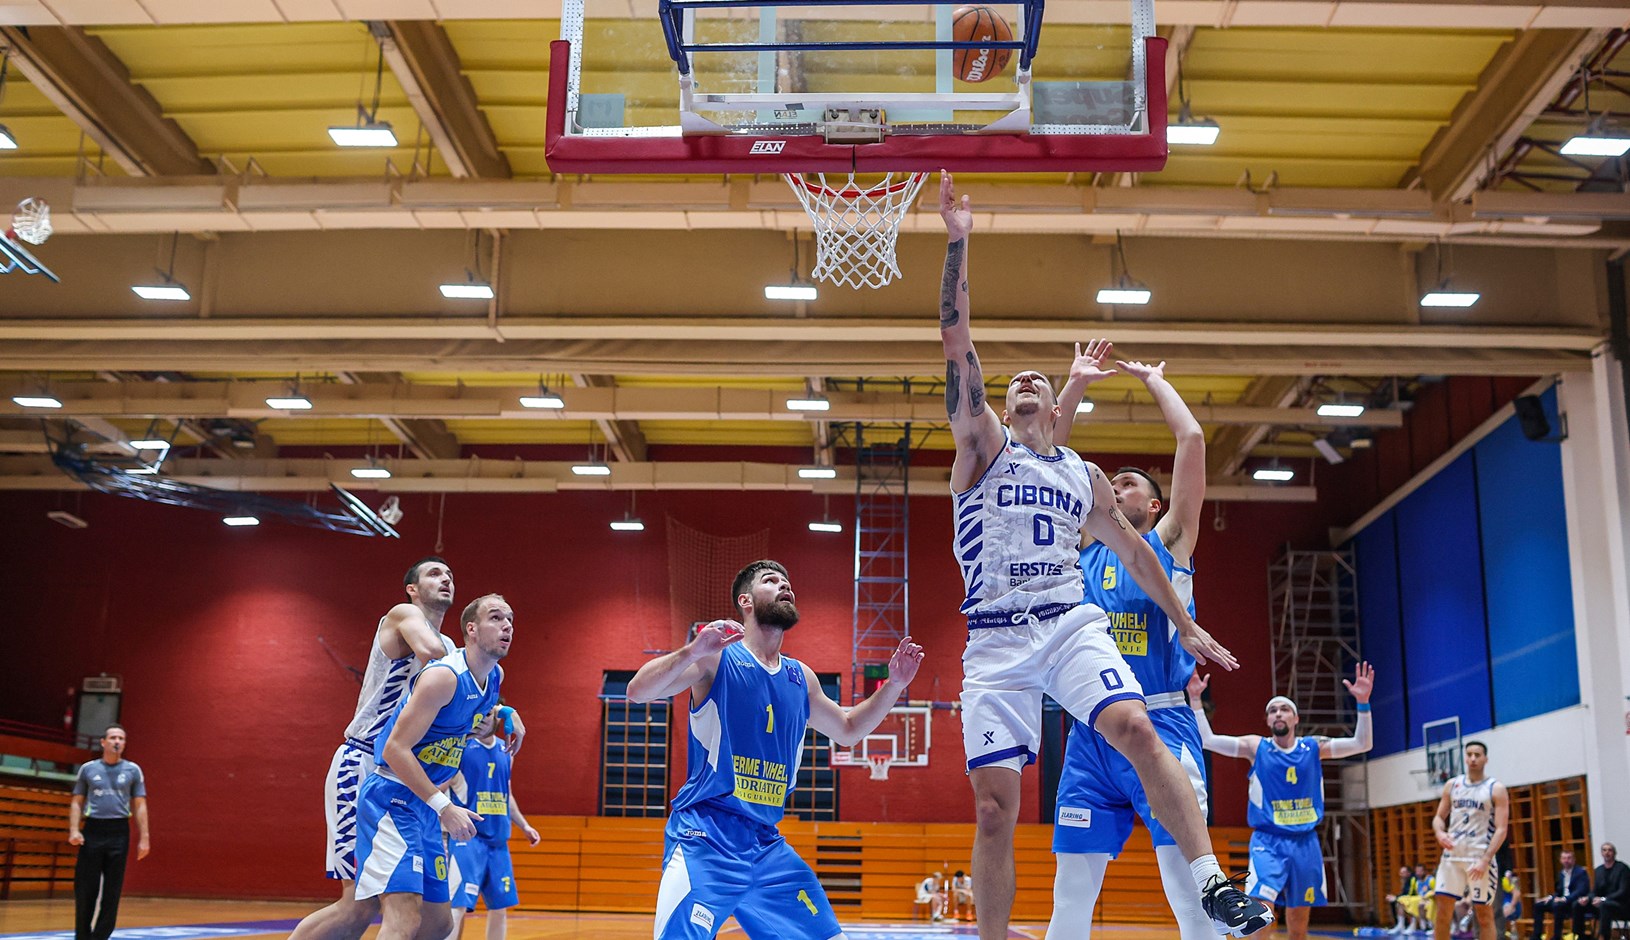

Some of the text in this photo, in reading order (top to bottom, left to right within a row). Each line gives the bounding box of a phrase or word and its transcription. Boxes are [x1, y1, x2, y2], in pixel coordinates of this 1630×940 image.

[966, 34, 992, 81] Wilson
[750, 141, 787, 154] ELAN
[997, 484, 1083, 523] CIBONA
[1033, 513, 1054, 546] 0
[1009, 578, 1031, 588] Ban
[1102, 565, 1117, 590] 5
[1100, 667, 1124, 691] 0
[766, 703, 774, 734] 1
[487, 762, 496, 779] 7
[732, 755, 761, 776] ERME
[1286, 766, 1298, 785] 4
[1462, 812, 1470, 825] 3
[434, 855, 447, 881] 6
[796, 889, 819, 916] 1
[1304, 886, 1315, 905] 4
[1473, 887, 1481, 899] 3
